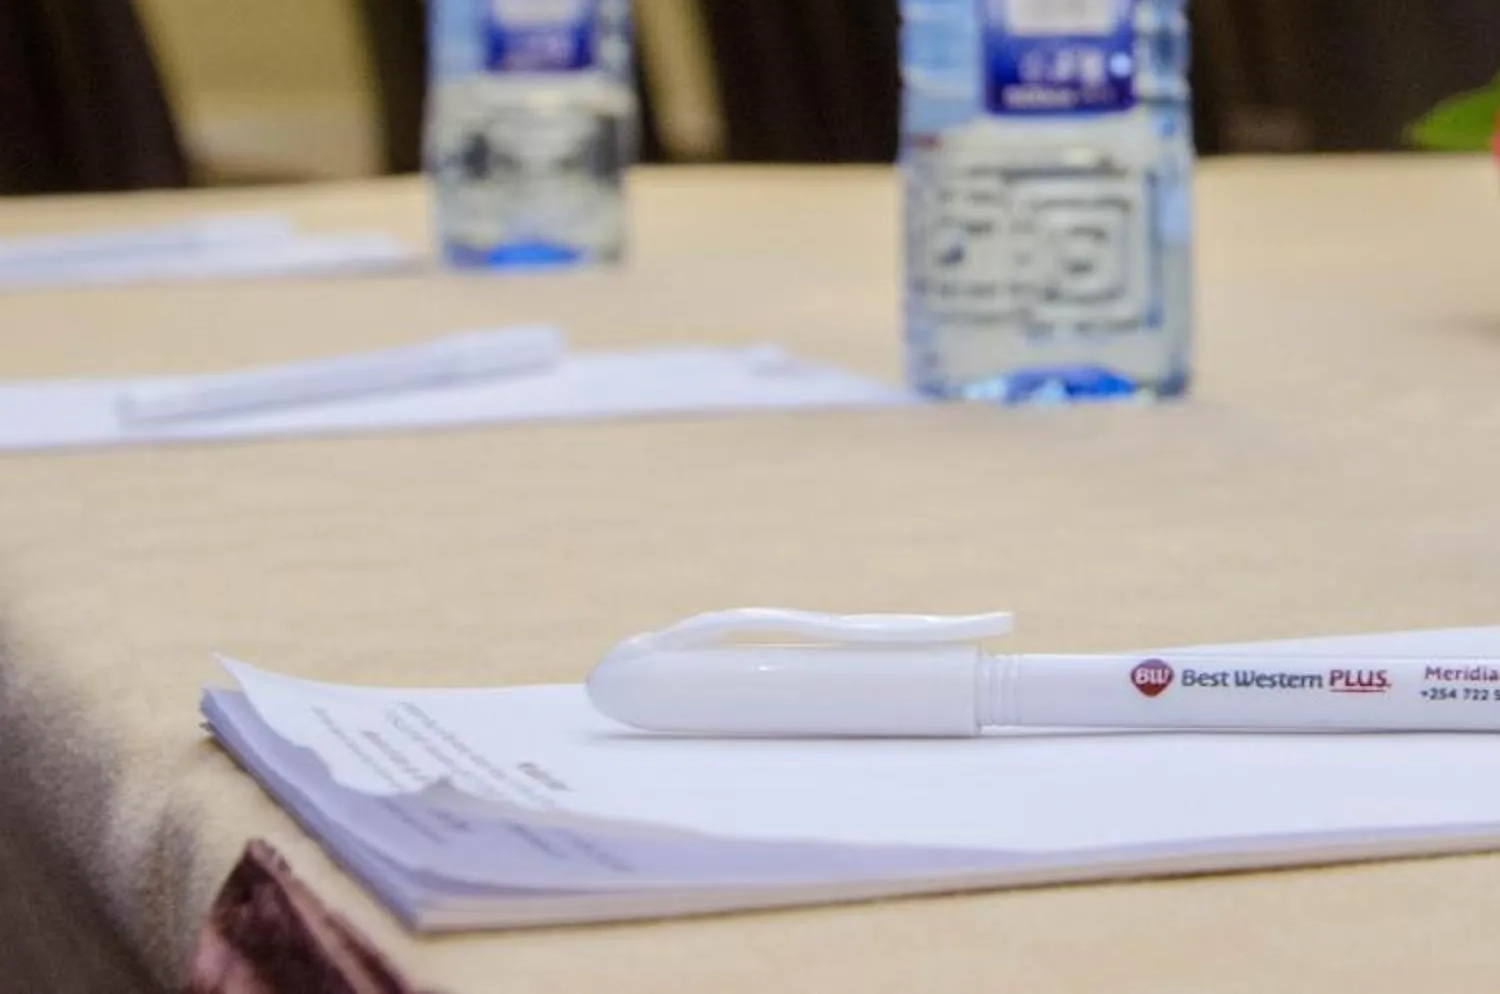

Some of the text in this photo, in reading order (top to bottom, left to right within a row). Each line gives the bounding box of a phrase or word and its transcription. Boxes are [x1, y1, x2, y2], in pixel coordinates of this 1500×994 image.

[1181, 669, 1230, 686] Best
[1233, 669, 1324, 688] Western
[1420, 688, 1457, 700] +254
[1463, 688, 1489, 701] 722
